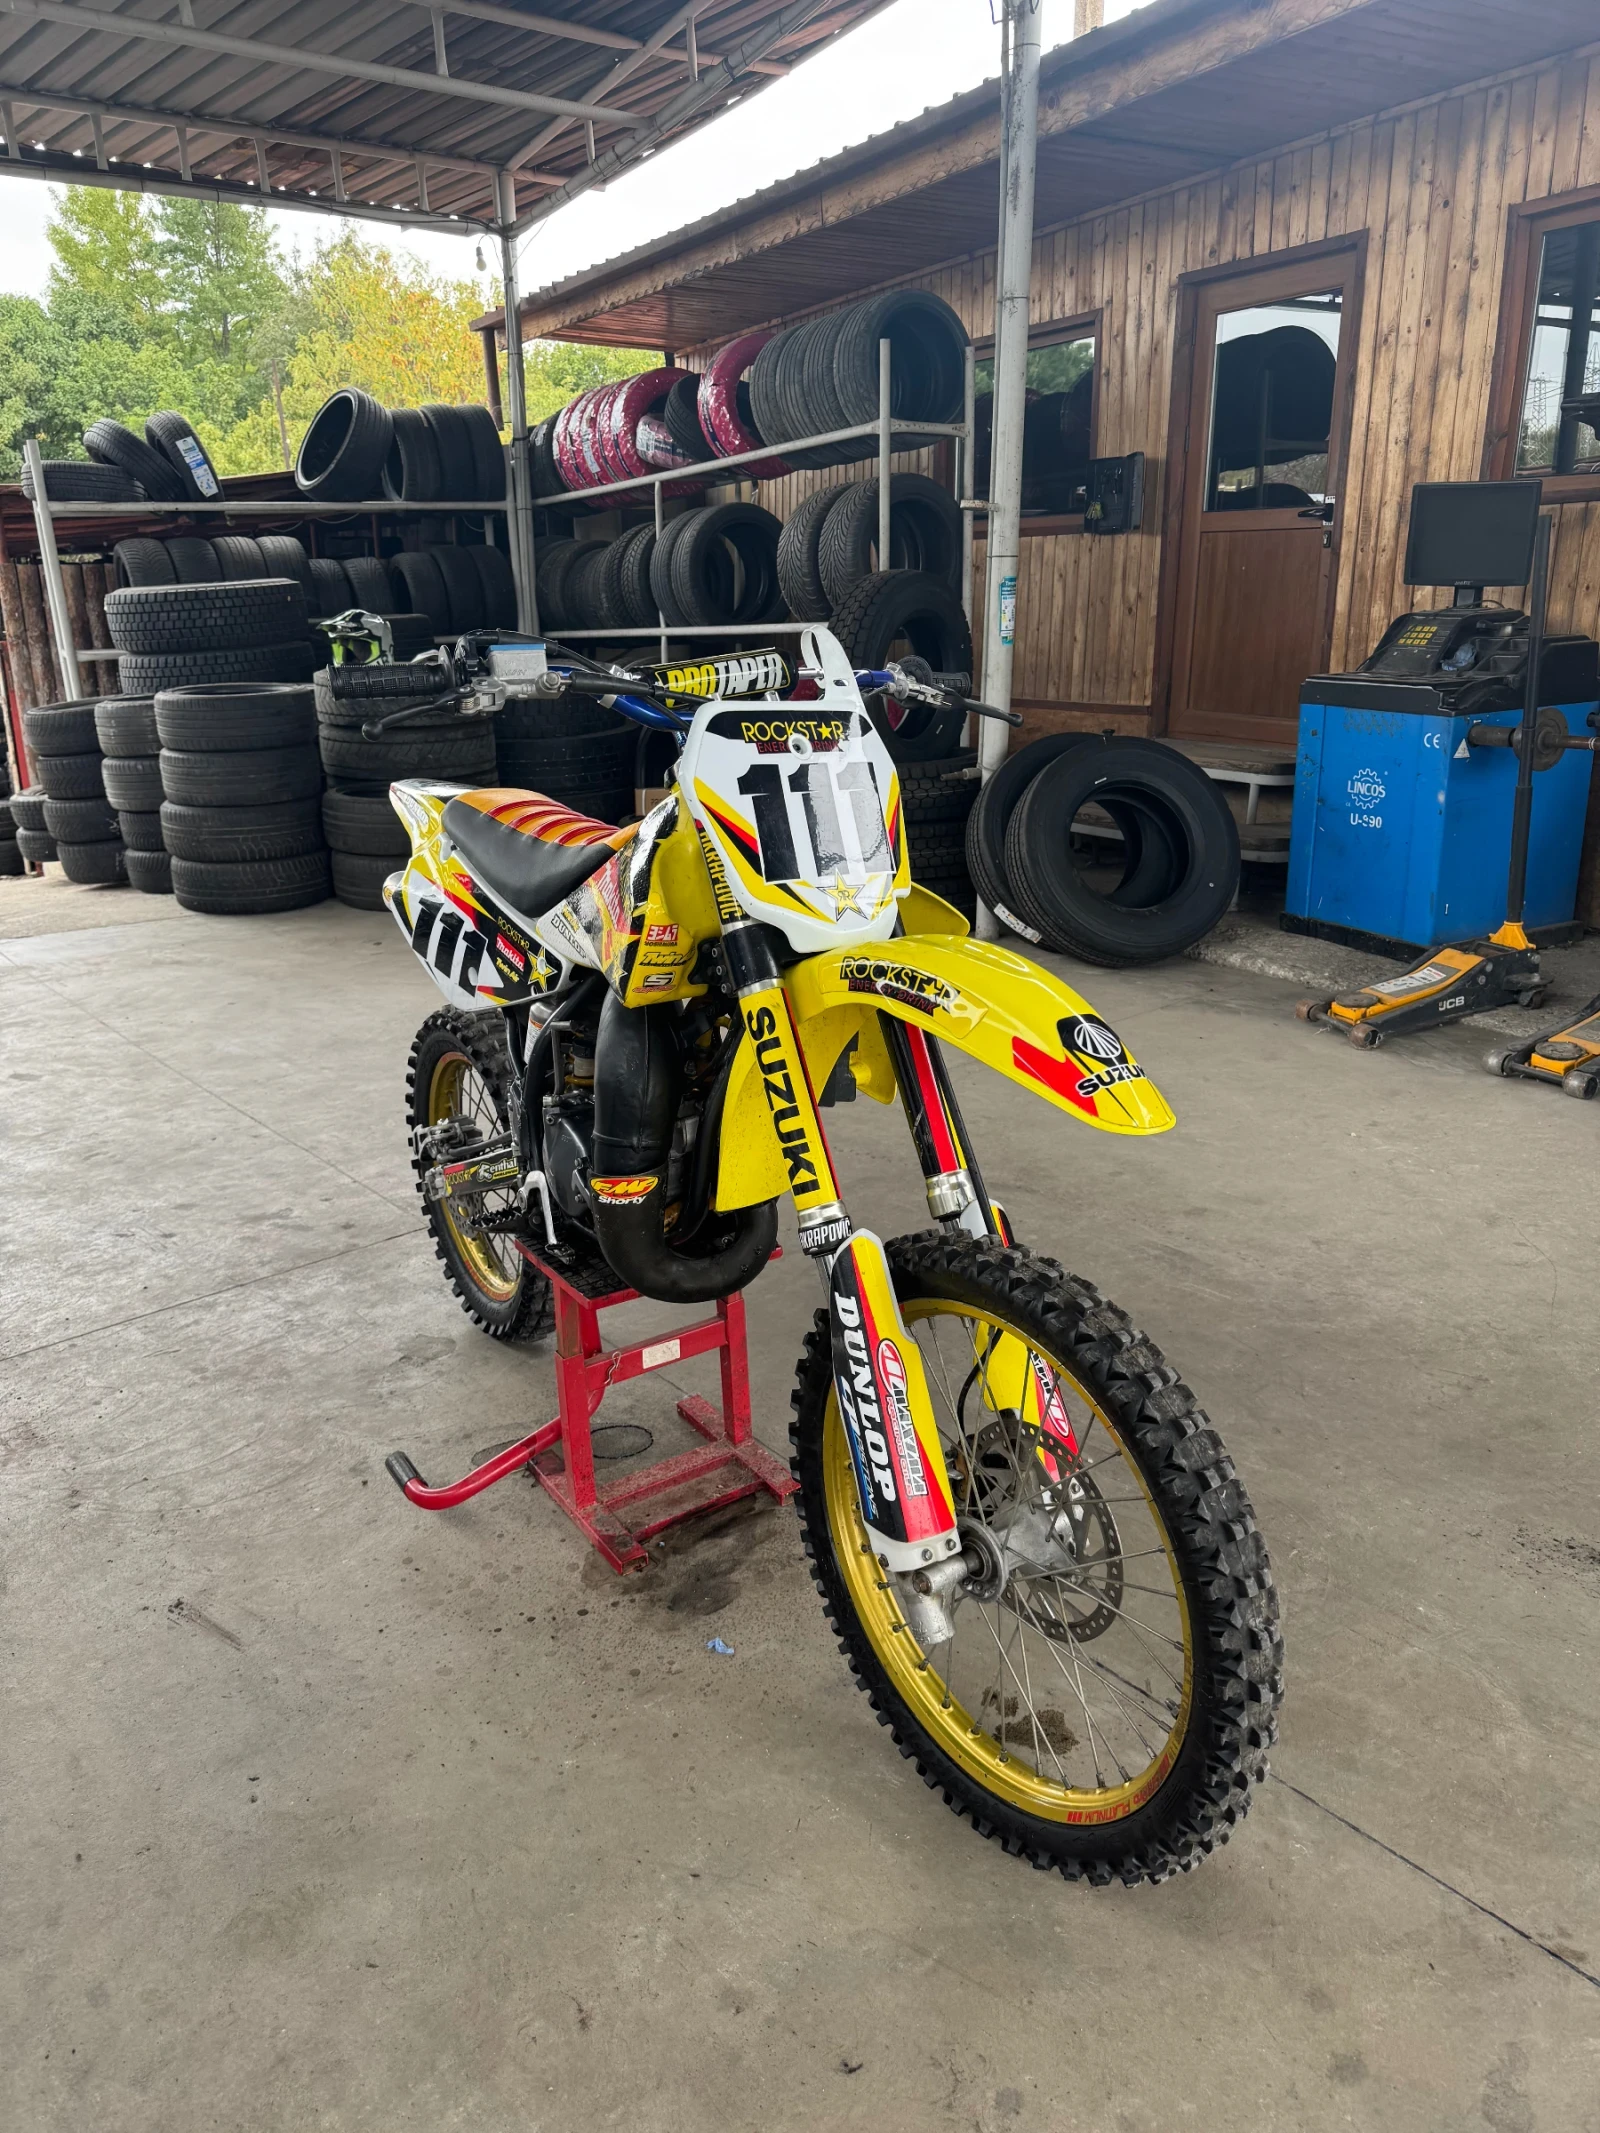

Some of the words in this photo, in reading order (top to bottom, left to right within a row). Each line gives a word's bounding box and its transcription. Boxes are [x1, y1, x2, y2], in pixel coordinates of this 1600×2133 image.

[758, 741, 791, 753] ENER
[1424, 733, 1441, 749] CE
[1347, 780, 1386, 798] LINCOS
[737, 762, 896, 883] 111
[412, 897, 488, 998] 111
[896, 990, 937, 1013] DRINK
[1438, 996, 1465, 1011] JCB
[747, 1006, 821, 1197] SUZUKI
[479, 1158, 517, 1181] Renthal
[594, 1178, 656, 1194] FMF
[598, 1195, 647, 1204] Shorty
[834, 1291, 896, 1502] DUNLOP
[887, 1397, 905, 1456] RACING
[900, 1457, 914, 1497] OILS
